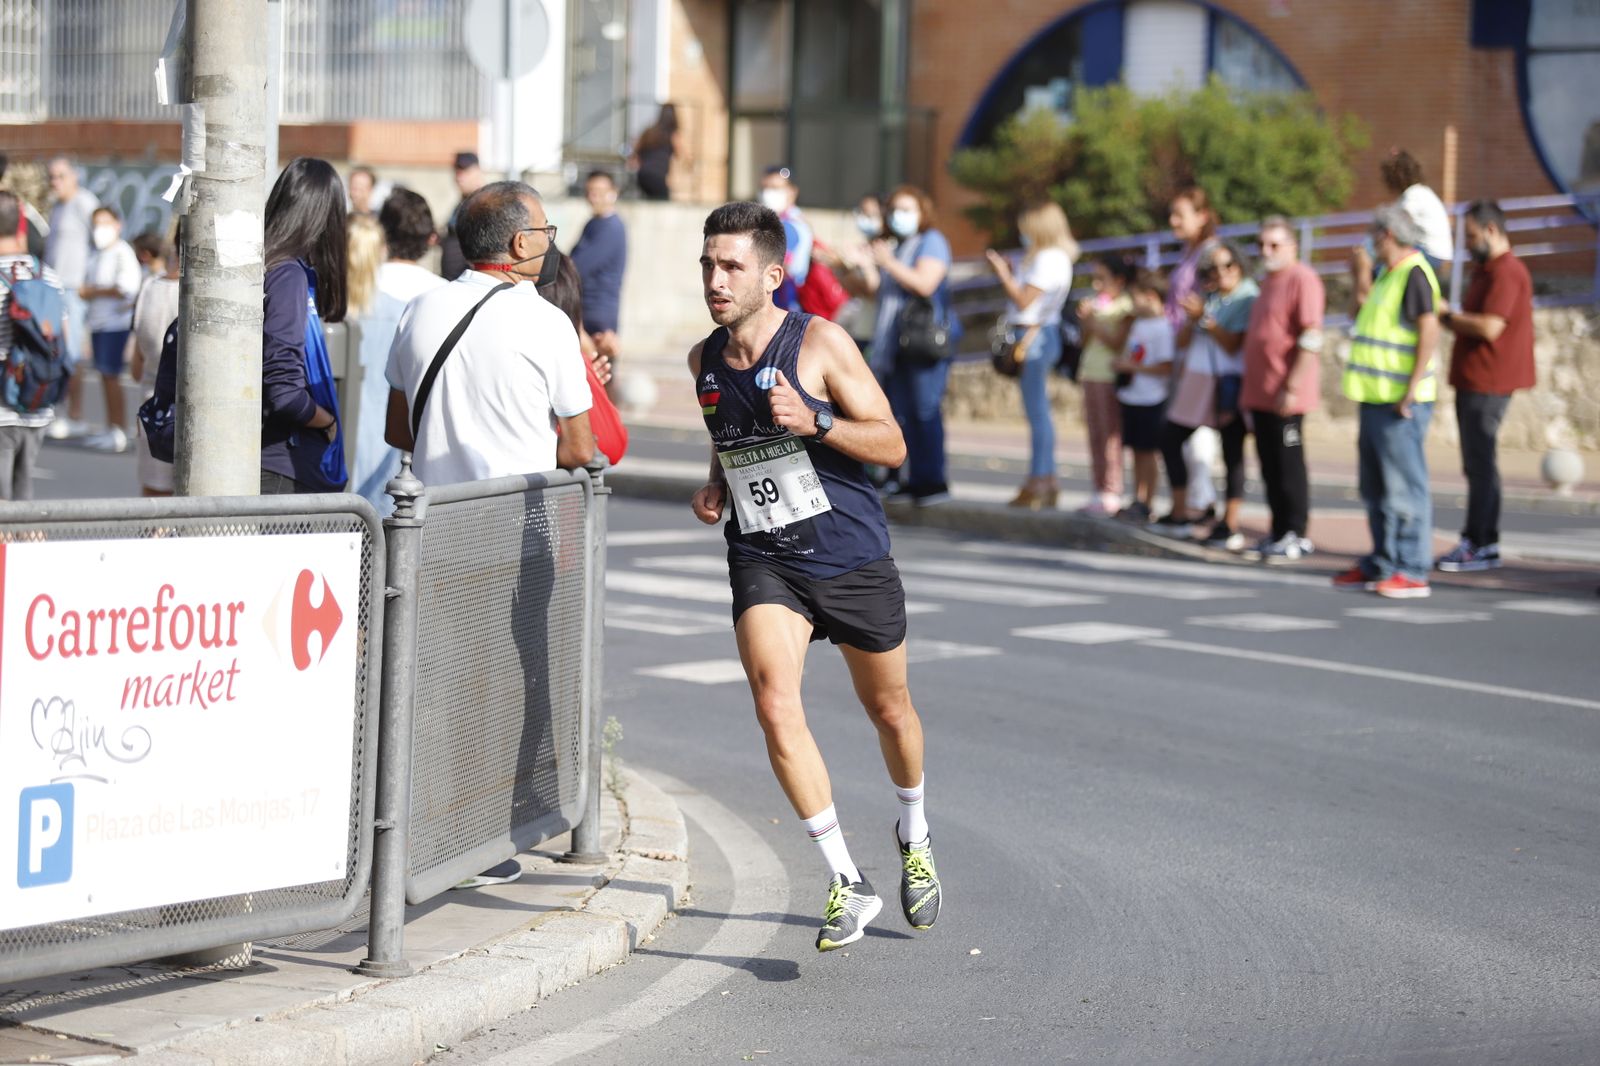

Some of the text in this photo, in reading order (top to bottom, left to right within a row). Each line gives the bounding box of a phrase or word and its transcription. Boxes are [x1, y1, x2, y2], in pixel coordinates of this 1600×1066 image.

[731, 451, 760, 467] VUELTA
[760, 449, 767, 460] A
[767, 440, 799, 459] HUELVA
[748, 477, 780, 507] 59
[24, 583, 246, 661] Carrefour
[120, 657, 241, 711] market
[29, 797, 63, 875] P
[86, 787, 321, 844] Plaza de Las Monjas, 17
[909, 887, 938, 915] BROOKS
